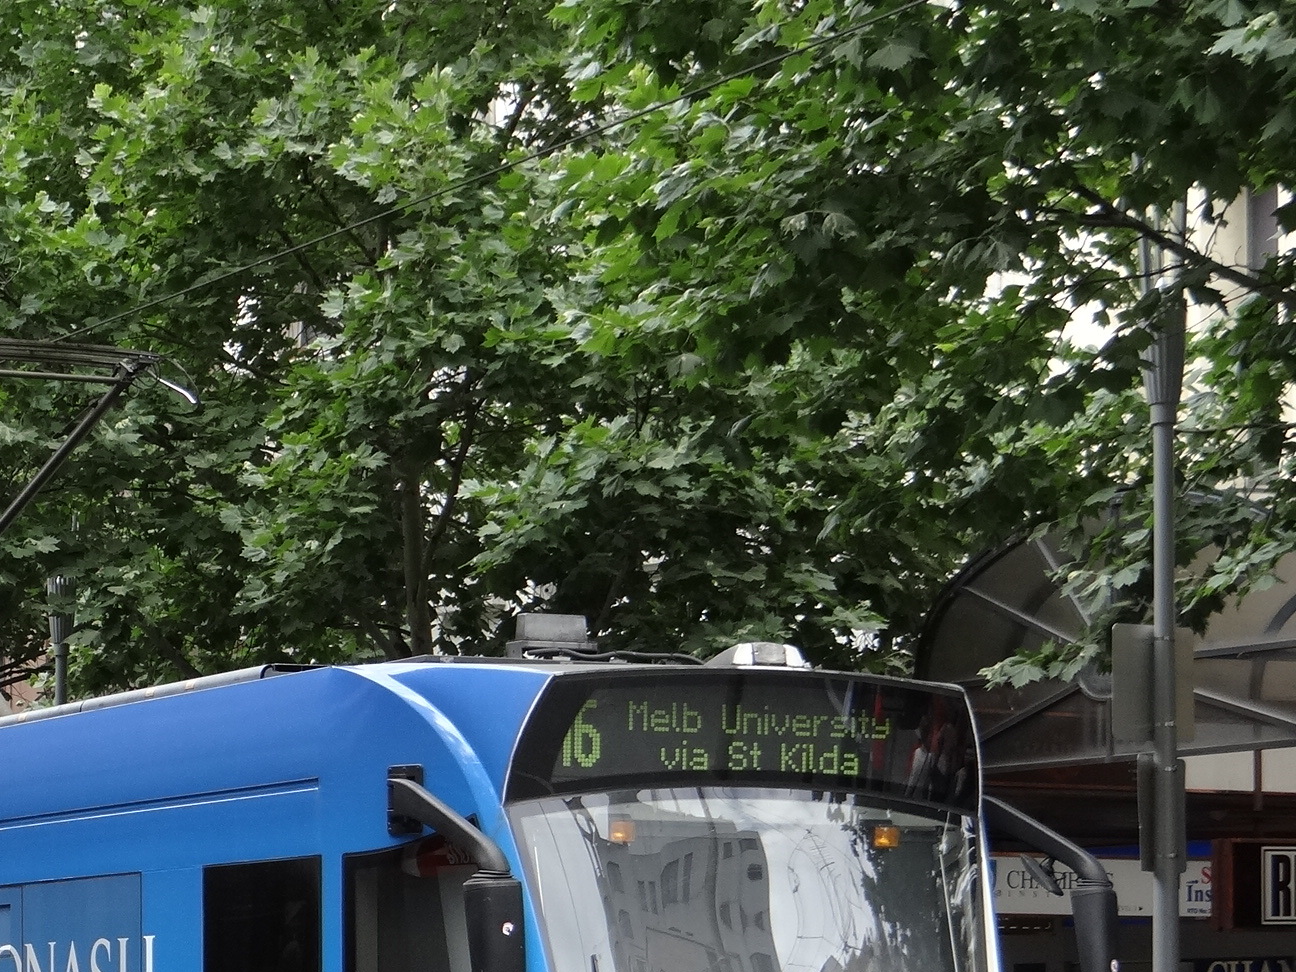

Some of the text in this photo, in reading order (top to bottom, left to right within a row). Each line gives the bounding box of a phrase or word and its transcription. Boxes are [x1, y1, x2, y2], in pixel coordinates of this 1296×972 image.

[628, 701, 702, 733] Melb
[721, 704, 890, 740] University
[660, 740, 859, 775] via St Kilda
